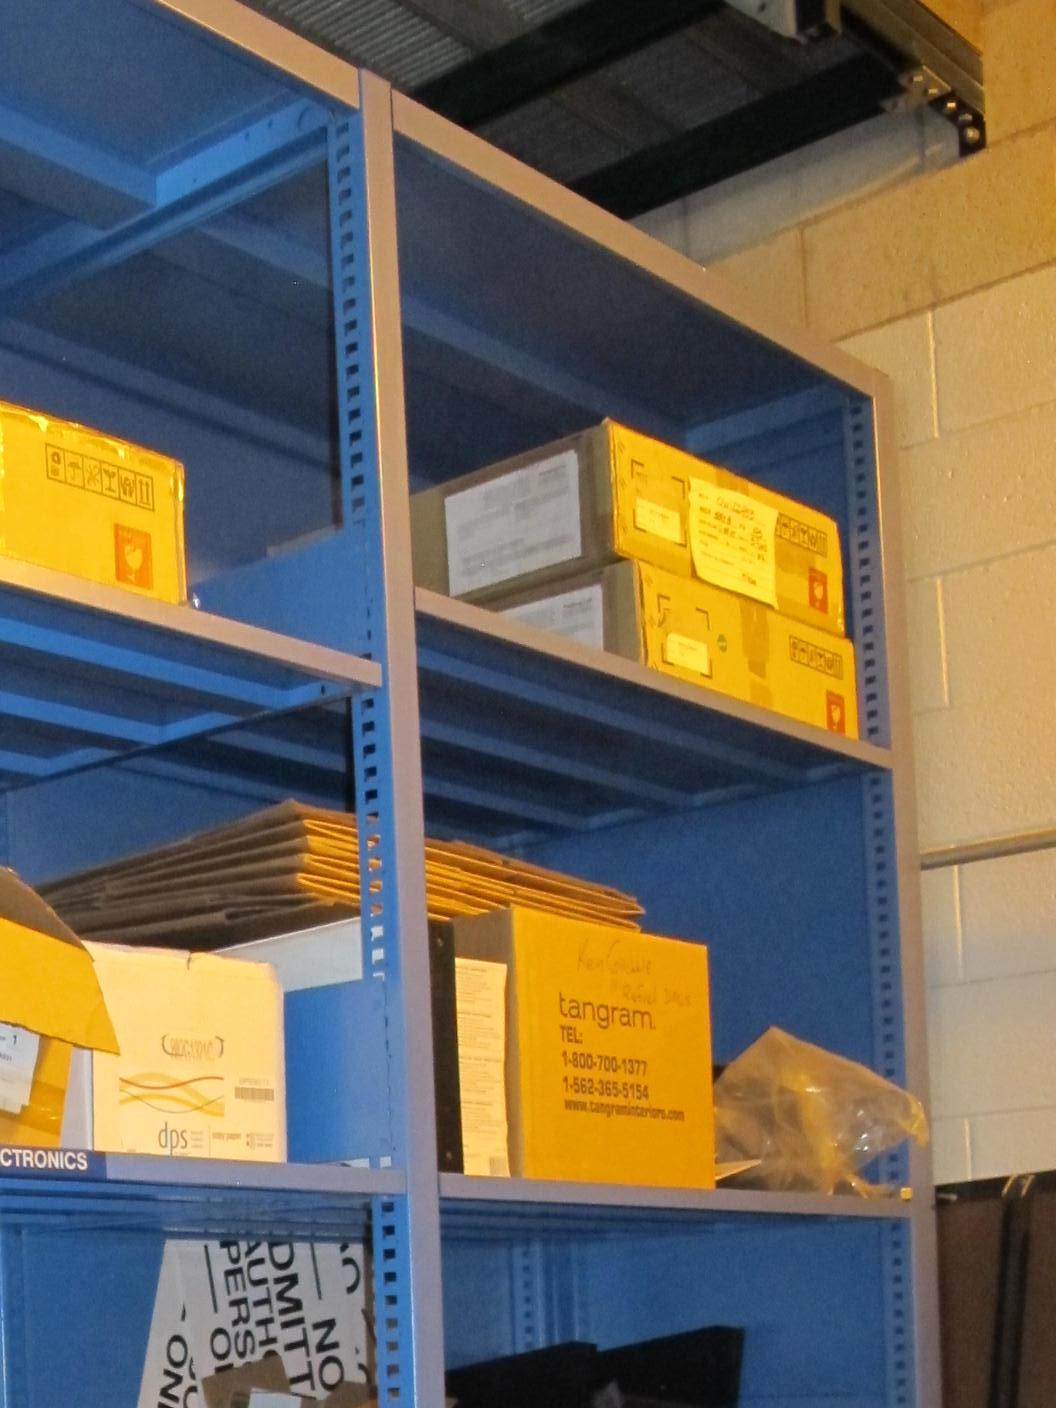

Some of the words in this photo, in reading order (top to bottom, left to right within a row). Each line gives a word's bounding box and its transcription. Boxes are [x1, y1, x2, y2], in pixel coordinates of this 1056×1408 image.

[560, 1025, 583, 1044] TEL:
[562, 1051, 647, 1076] 1-800-700-1377
[158, 1120, 188, 1157] dps
[219, 1241, 256, 1365] PERS
[244, 1241, 282, 1360] AUTH
[268, 1241, 318, 1400] DMITT
[312, 1318, 344, 1392] NO
